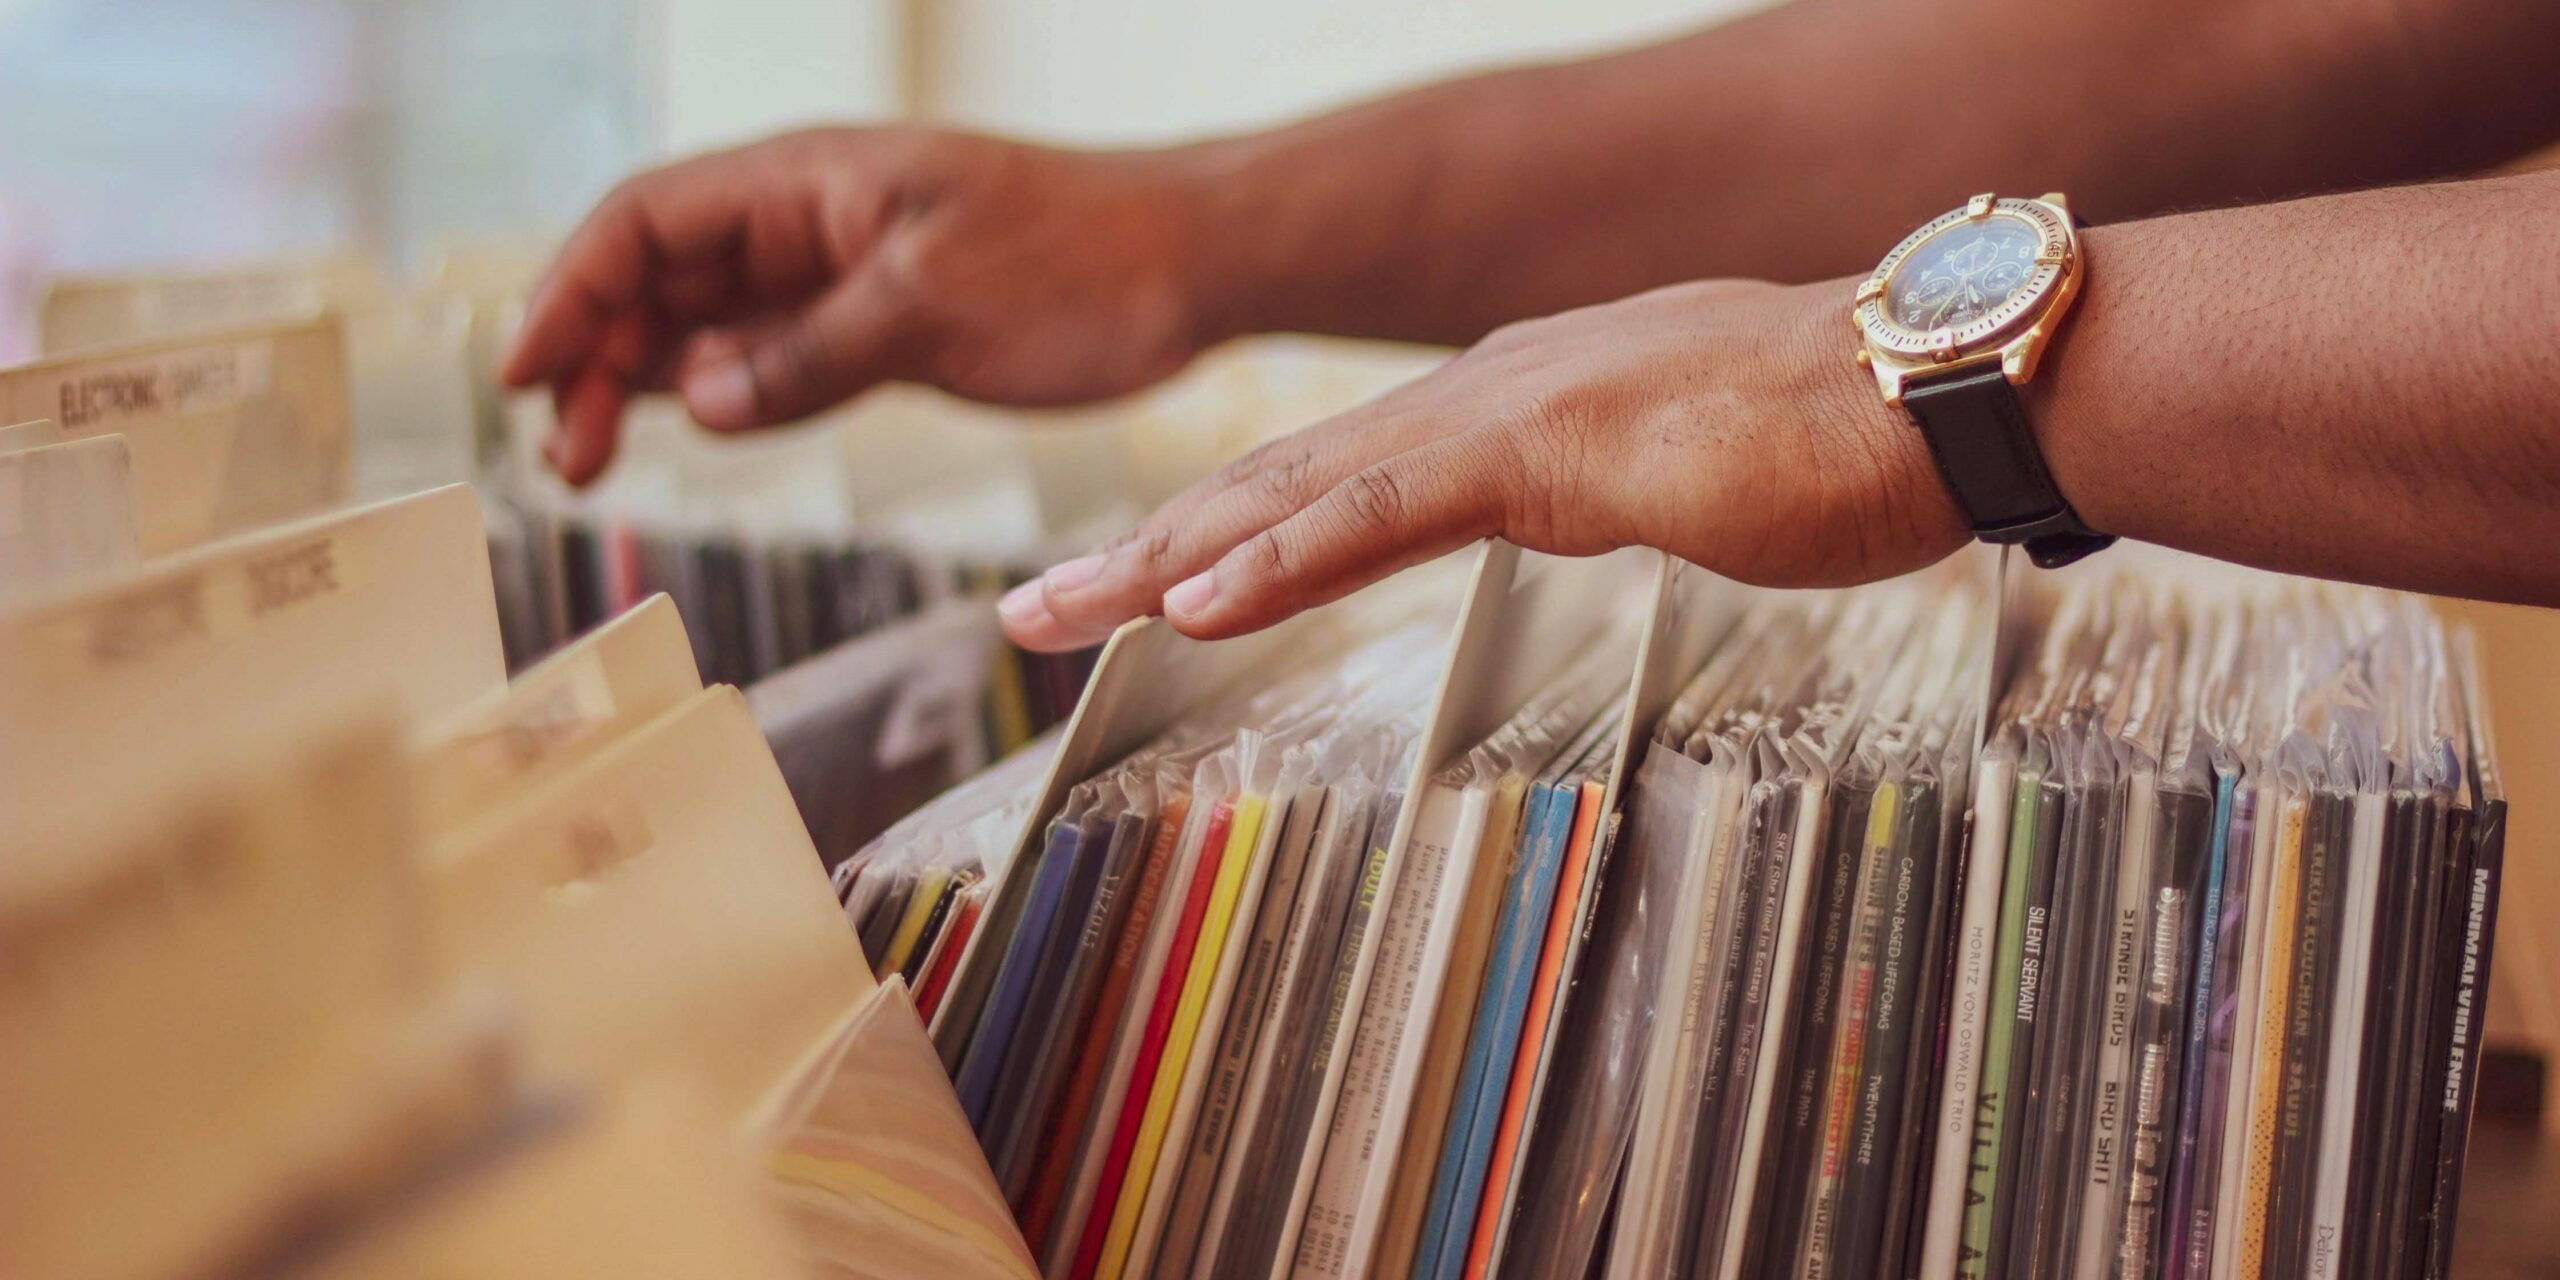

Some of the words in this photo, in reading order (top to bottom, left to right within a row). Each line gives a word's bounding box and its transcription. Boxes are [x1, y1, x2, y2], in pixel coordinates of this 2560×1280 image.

[1414, 842, 1436, 883] Vinyl
[1767, 864, 1781, 894] (She
[1830, 851, 1851, 908] CARBON
[1865, 844, 1890, 909] SHAWN
[1894, 855, 1914, 914] CARBON
[2305, 842, 2326, 919] KRIKOR
[1115, 819, 1177, 970] AUTOCREATION
[1760, 895, 1776, 930] Killed
[2204, 887, 2219, 936] ELECTRO
[1342, 921, 1366, 967] THIS
[1823, 910, 1841, 952] BASED
[1887, 915, 1905, 958] BASED
[1965, 925, 1984, 986] MORITZ
[2023, 905, 2045, 956] SILENT
[1746, 950, 1767, 1004] Ecstasy)
[1811, 953, 1834, 1024] LIFEFORMS
[2198, 938, 2213, 985] AVENUE
[1876, 959, 1898, 1031] LIFEFORMS
[1961, 990, 1977, 1024] VON
[2015, 956, 2039, 1023] SERVANT
[2192, 987, 2209, 1042] RECORDS
[1800, 1066, 1815, 1092] THE
[1953, 1028, 1972, 1092] OSWALD
[1822, 1071, 1853, 1179] ORCHESTRA
[1856, 1073, 1881, 1166] TWENTYTHREE
[1948, 1097, 1964, 1134] TRIO
[2100, 1080, 2117, 1131] BIRD
[1964, 1089, 1997, 1209] VILLA
[2188, 1208, 2209, 1270] RADIUS
